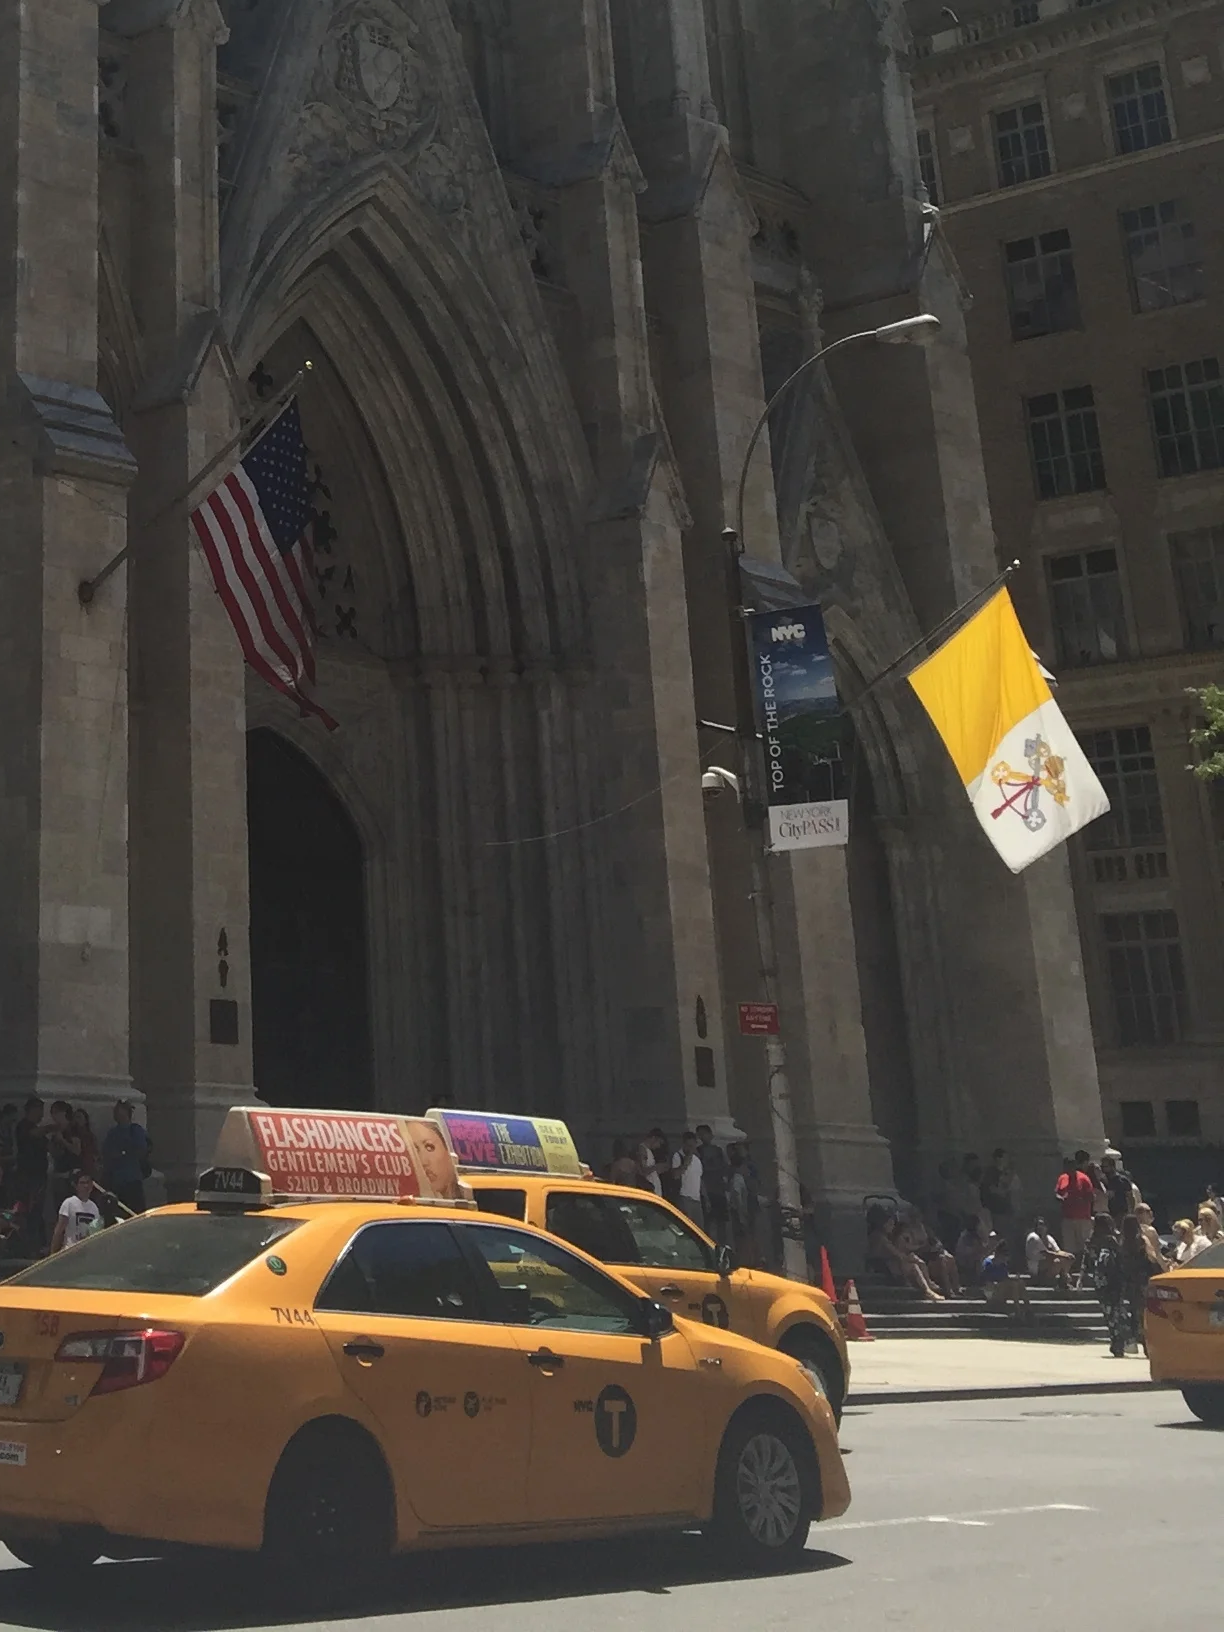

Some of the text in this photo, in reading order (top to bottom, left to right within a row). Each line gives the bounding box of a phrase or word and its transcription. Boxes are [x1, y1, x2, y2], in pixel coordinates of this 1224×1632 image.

[771, 623, 806, 641] NYC
[759, 653, 785, 792] TOP OF THE ROCK
[256, 1115, 407, 1154] FLASHDANCERS
[491, 1122, 514, 1144] THE
[453, 1139, 500, 1165] LIVE
[266, 1150, 412, 1177] GENTLEMEN'S CLUB
[214, 1171, 245, 1190] 7V44
[286, 1175, 401, 1196] 52ND & BROADWAY
[270, 1306, 315, 1326] 7V44
